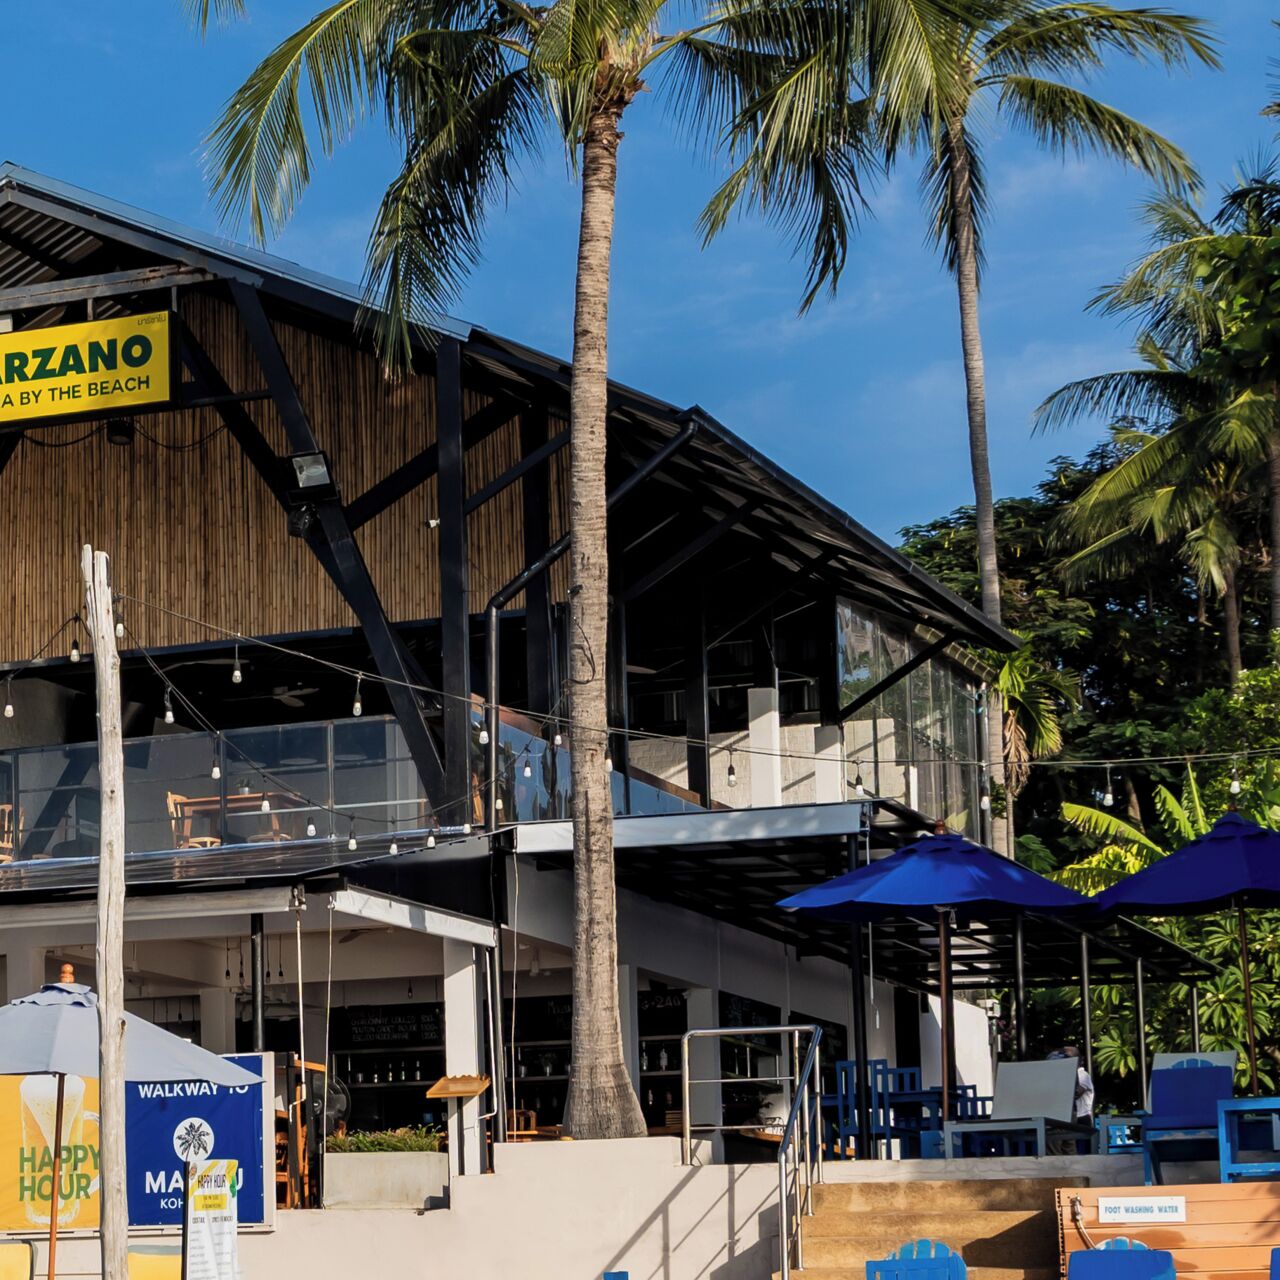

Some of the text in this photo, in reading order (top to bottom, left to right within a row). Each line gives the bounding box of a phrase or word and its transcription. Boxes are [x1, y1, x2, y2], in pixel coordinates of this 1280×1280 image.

[20, 389, 42, 405] BY
[48, 385, 81, 402] THE
[88, 375, 150, 396] BEACH
[138, 1082, 218, 1098] WALKWAY
[19, 1173, 91, 1201] HOUR
[1105, 1205, 1179, 1214] FOOT WASHING WATER
